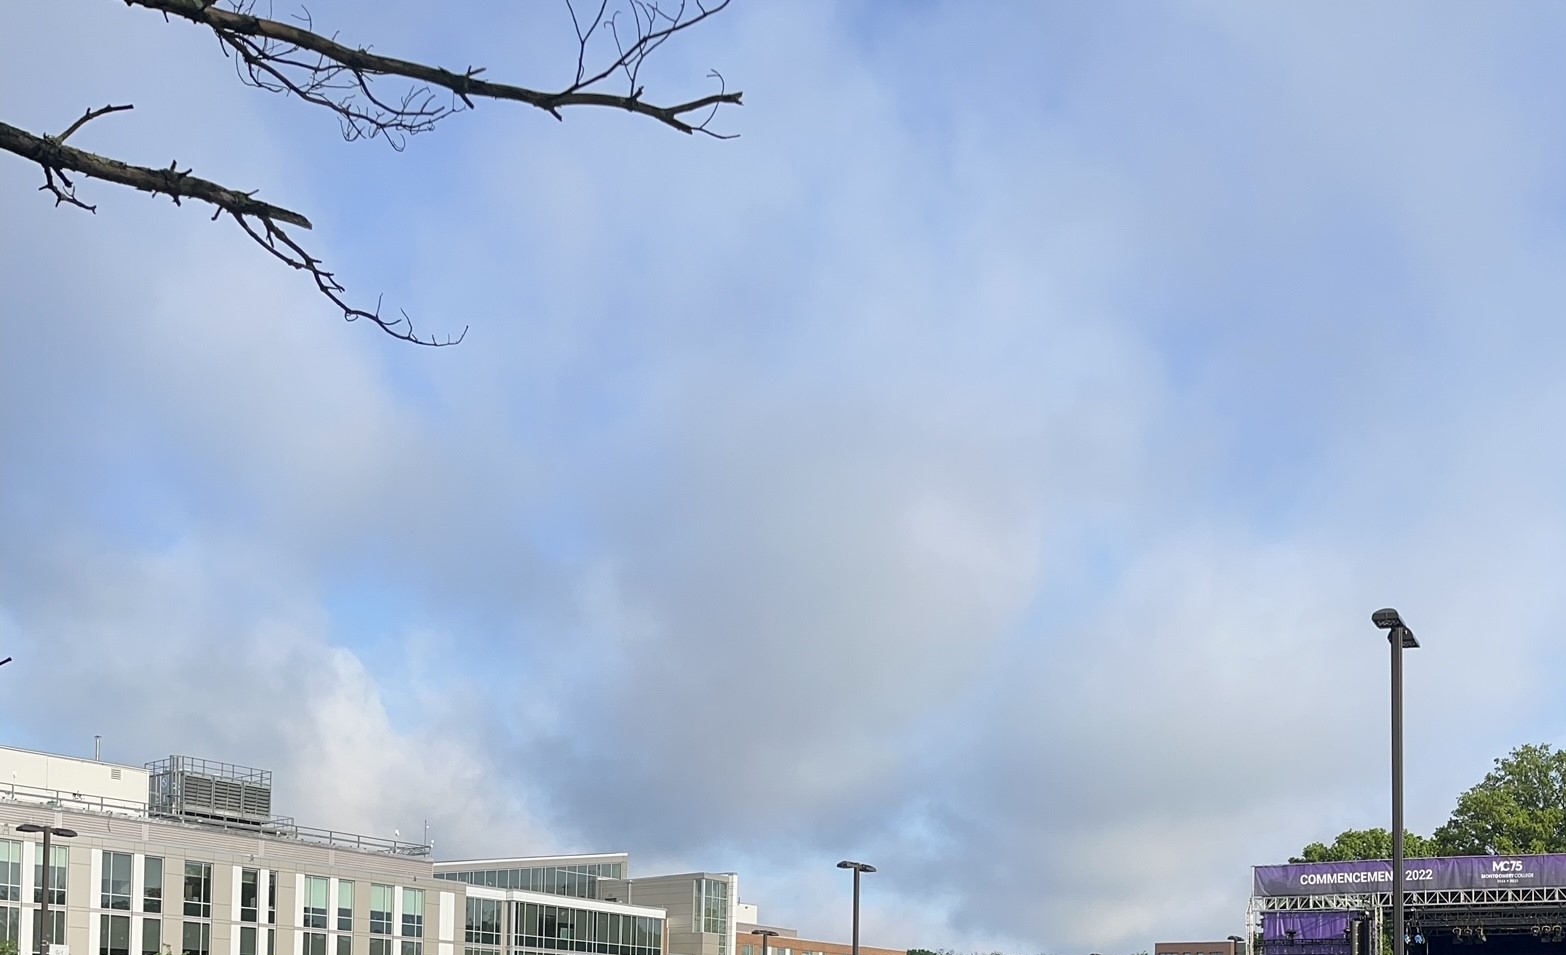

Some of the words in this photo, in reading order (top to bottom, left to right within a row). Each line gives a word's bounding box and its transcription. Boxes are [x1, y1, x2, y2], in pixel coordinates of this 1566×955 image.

[1492, 860, 1523, 872] MC75
[1300, 871, 1393, 885] COMMENCEMEN
[1405, 869, 1433, 880] 2022
